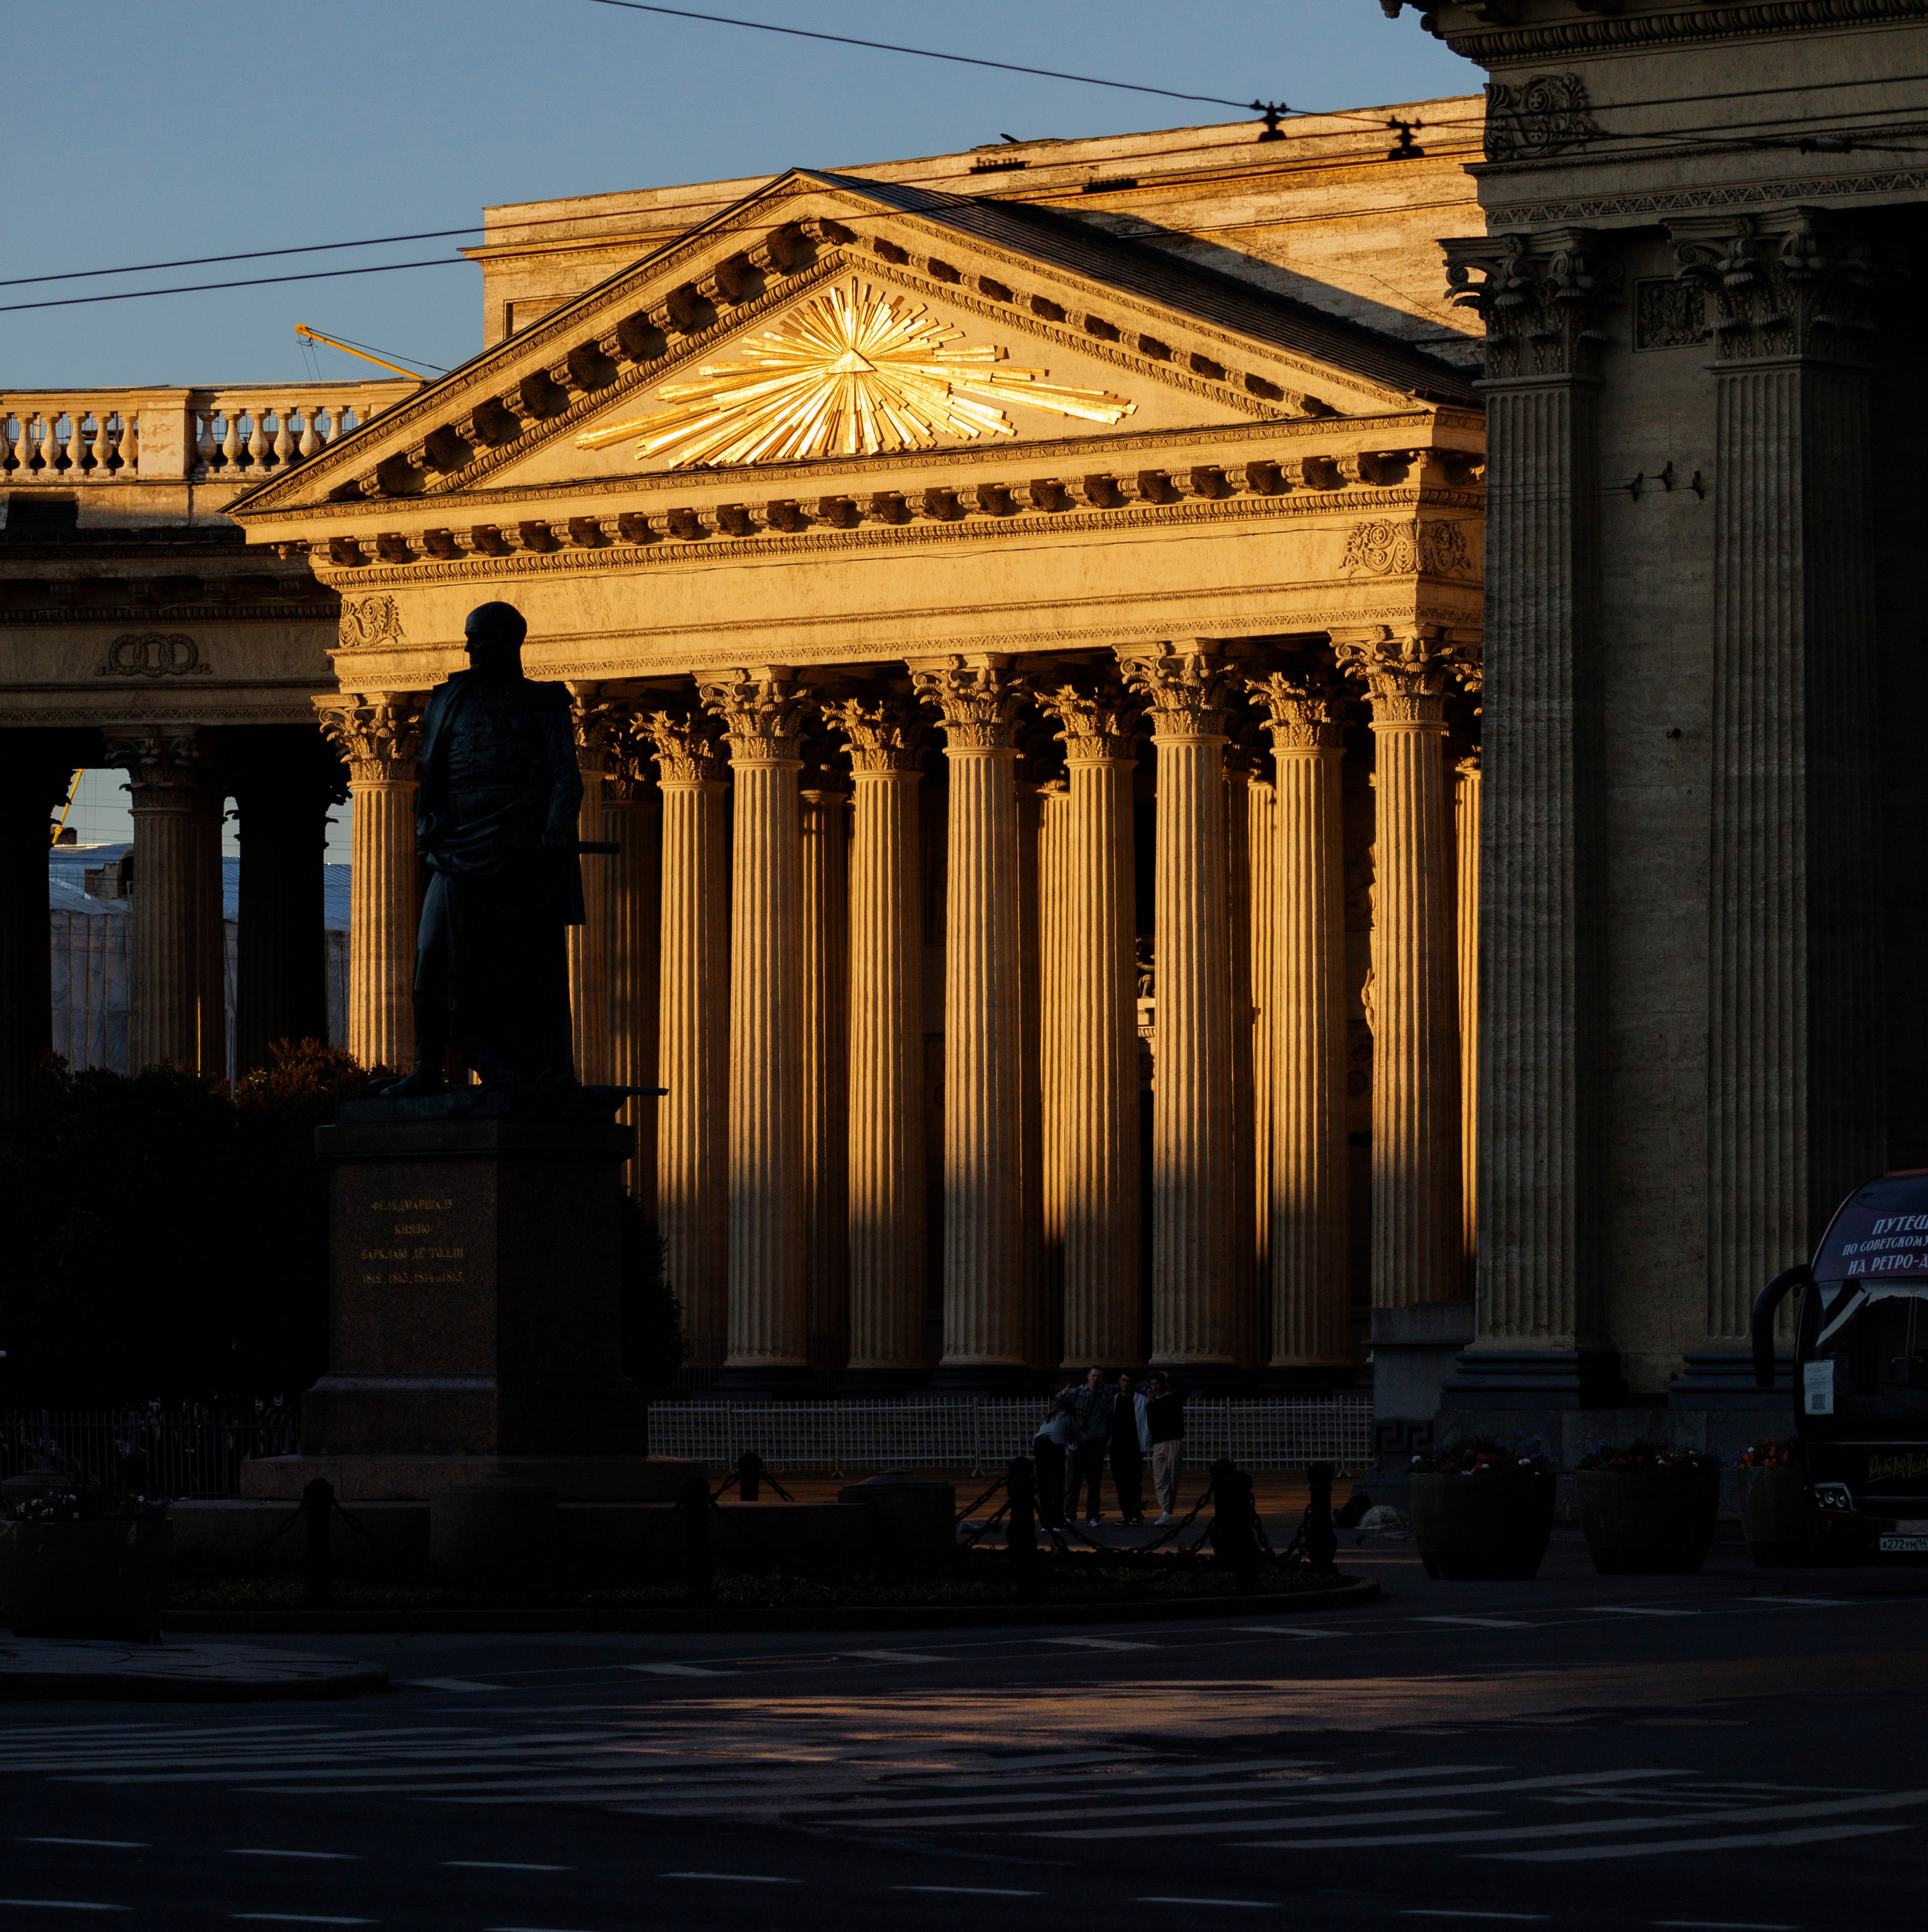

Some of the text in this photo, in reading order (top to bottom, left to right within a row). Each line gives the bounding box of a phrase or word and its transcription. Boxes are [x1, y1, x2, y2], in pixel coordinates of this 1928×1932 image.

[394, 1223, 430, 1235] КНЯЗЮ
[411, 1247, 426, 1260] ДЕ
[1842, 1243, 1858, 1256] ПО
[1847, 1259, 1865, 1276] НА
[1883, 1539, 1917, 1549] А272УМ
